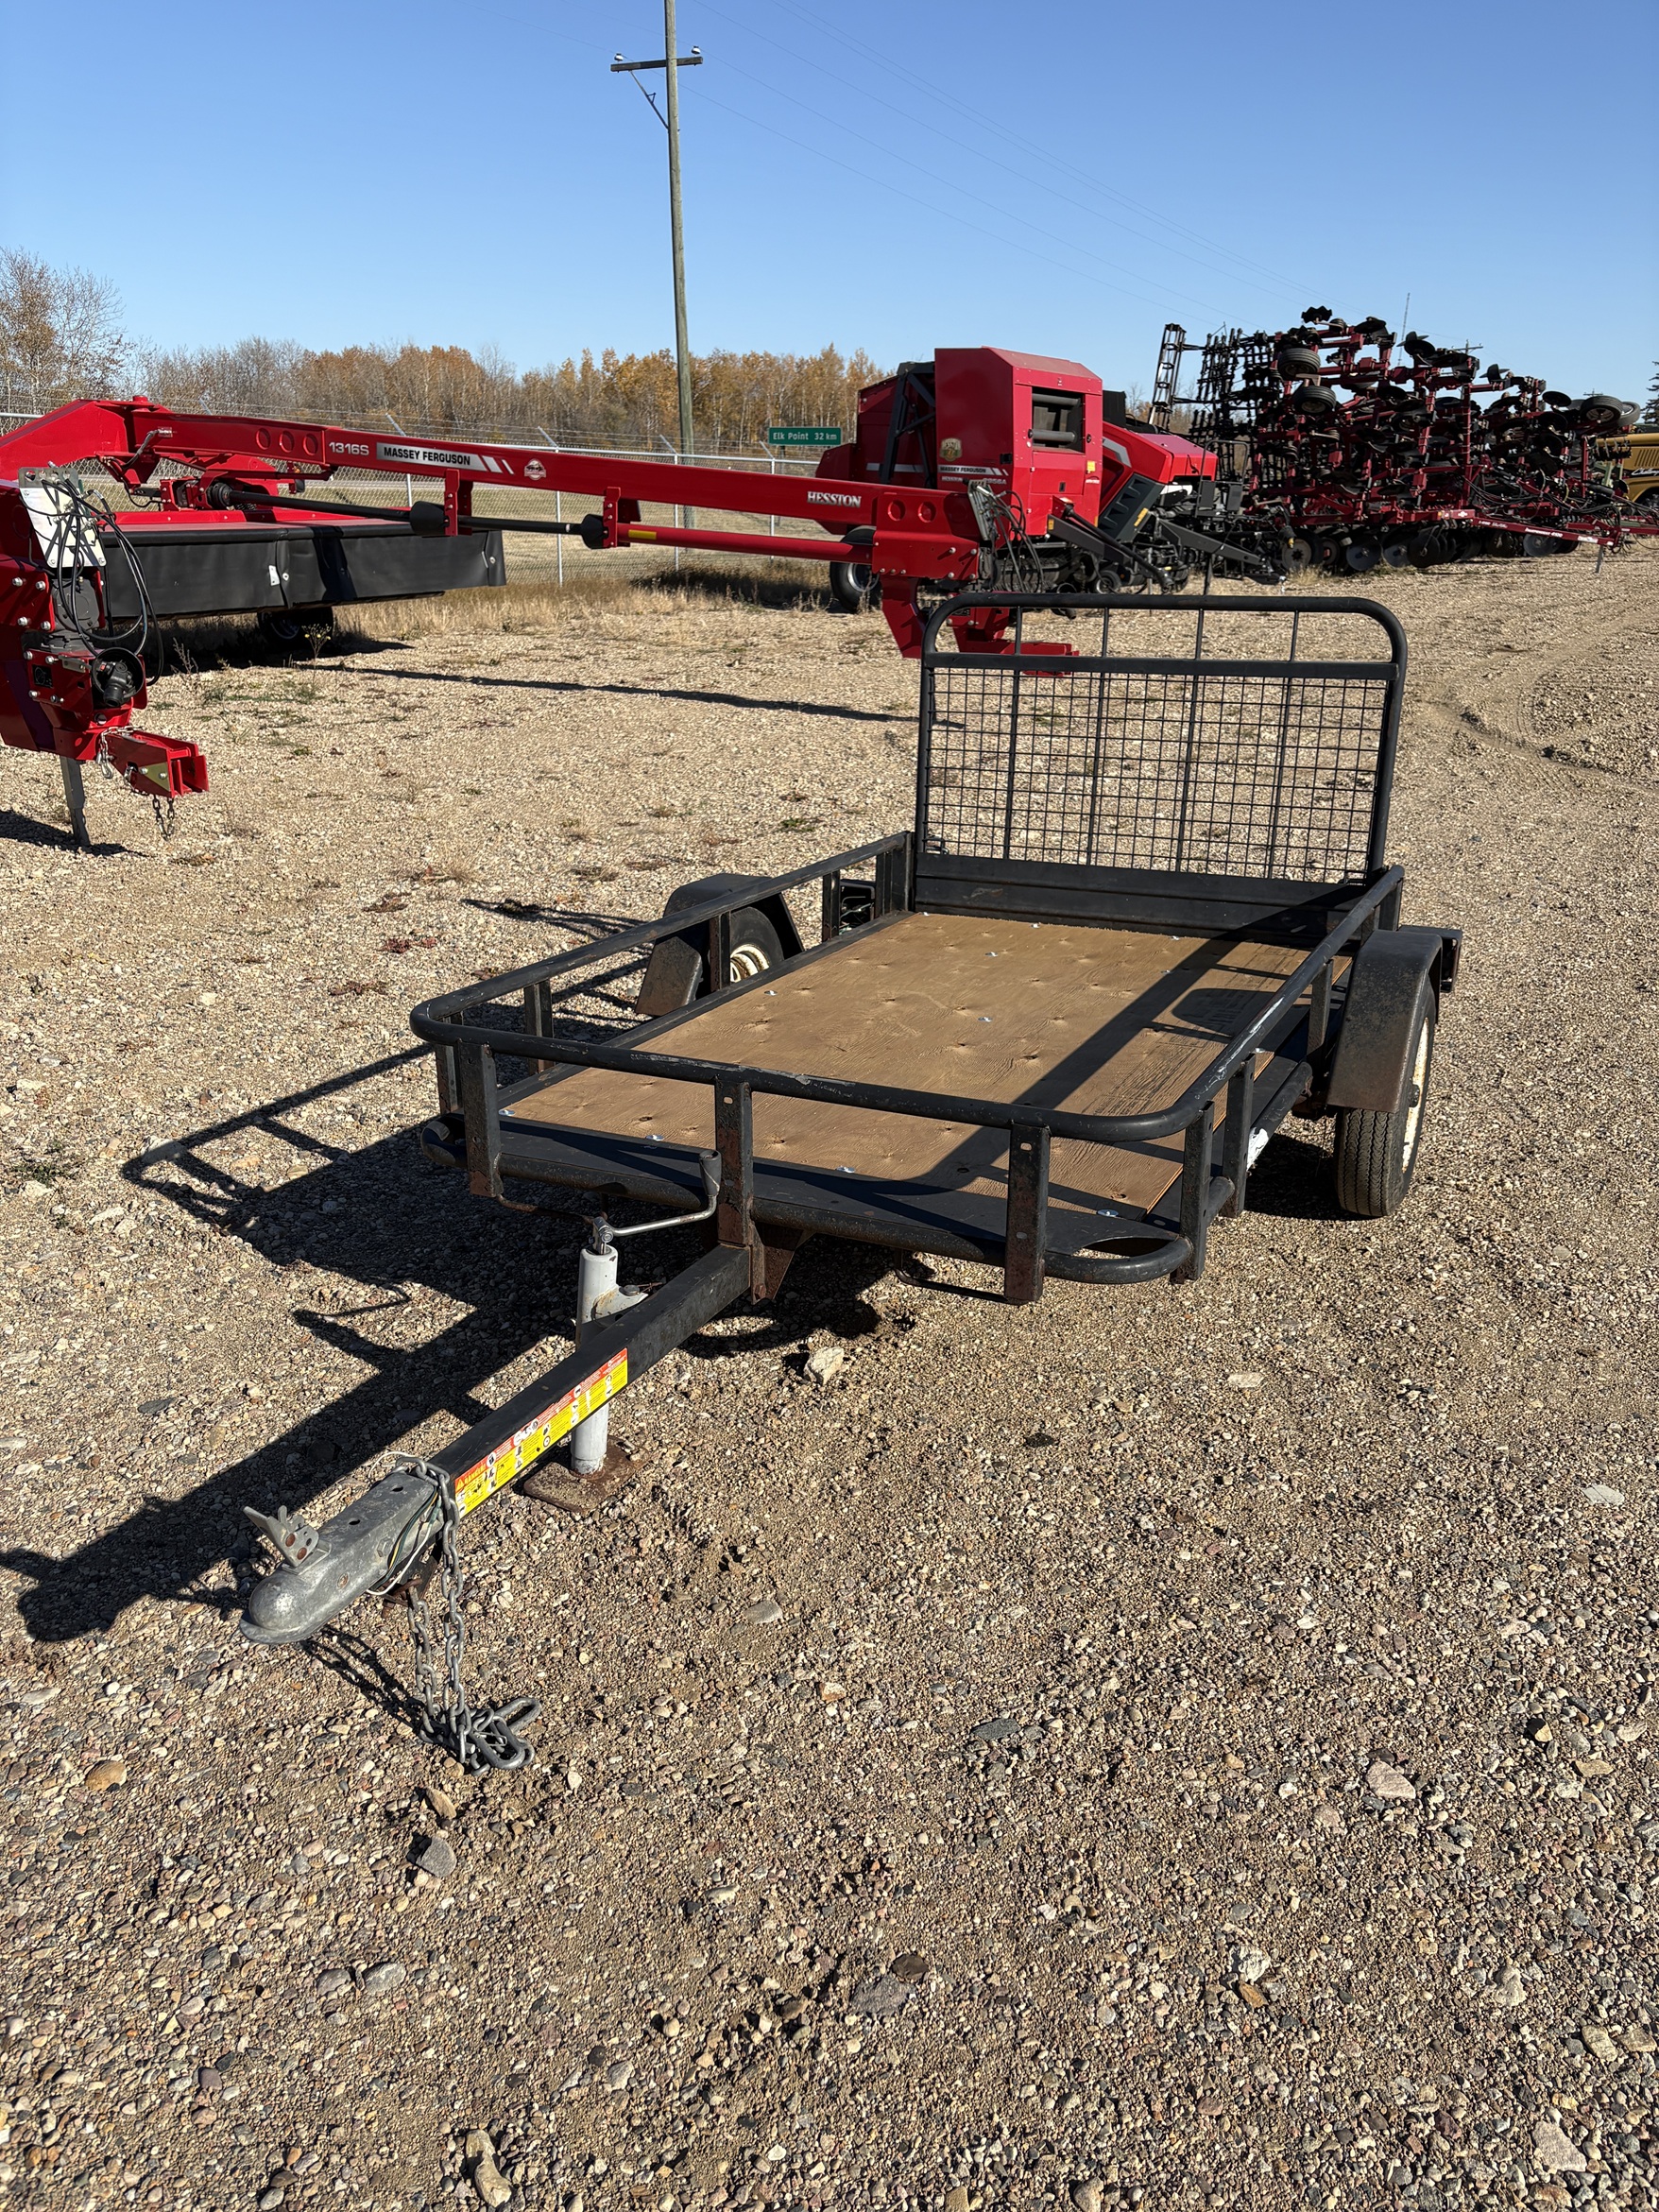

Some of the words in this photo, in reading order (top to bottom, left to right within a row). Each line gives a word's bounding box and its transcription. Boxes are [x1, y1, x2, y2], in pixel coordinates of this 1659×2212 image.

[773, 432, 785, 440] Elk
[787, 432, 809, 440] Point
[814, 432, 825, 440] 32
[826, 432, 837, 440] km
[329, 441, 369, 456] 1316S
[384, 446, 420, 460] MASSEY
[422, 450, 470, 466] FERGUSON
[807, 490, 862, 508] HESSTON
